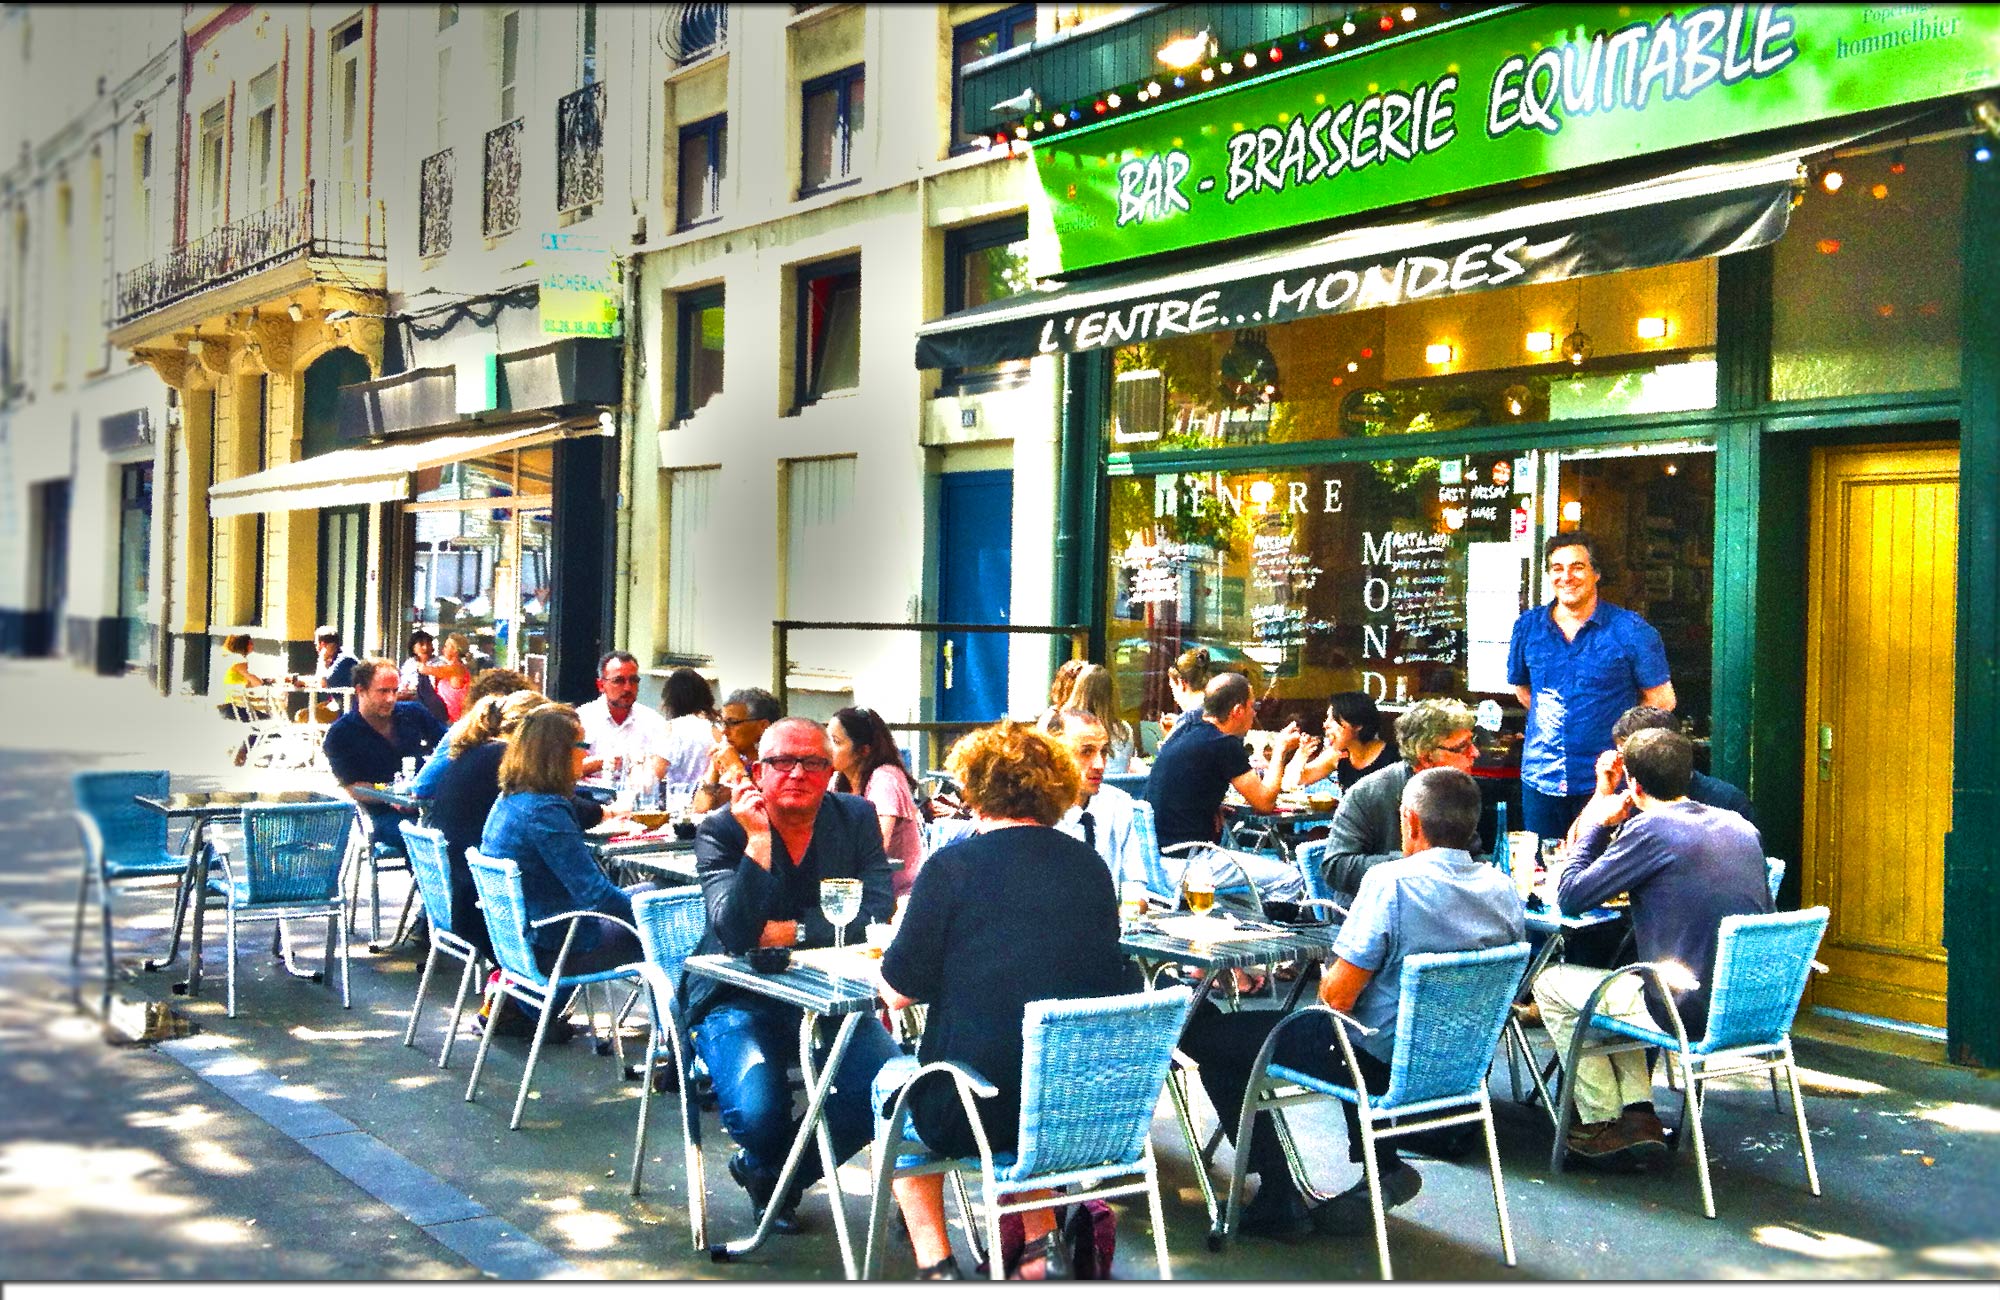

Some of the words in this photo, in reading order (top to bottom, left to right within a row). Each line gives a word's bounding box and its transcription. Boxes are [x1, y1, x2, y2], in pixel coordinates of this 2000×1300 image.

[1837, 15, 1961, 59] hommelbier
[1117, 150, 1190, 227] BAR
[1227, 75, 1458, 203] BRASSERIE
[1484, 3, 1798, 137] EQUITABLE
